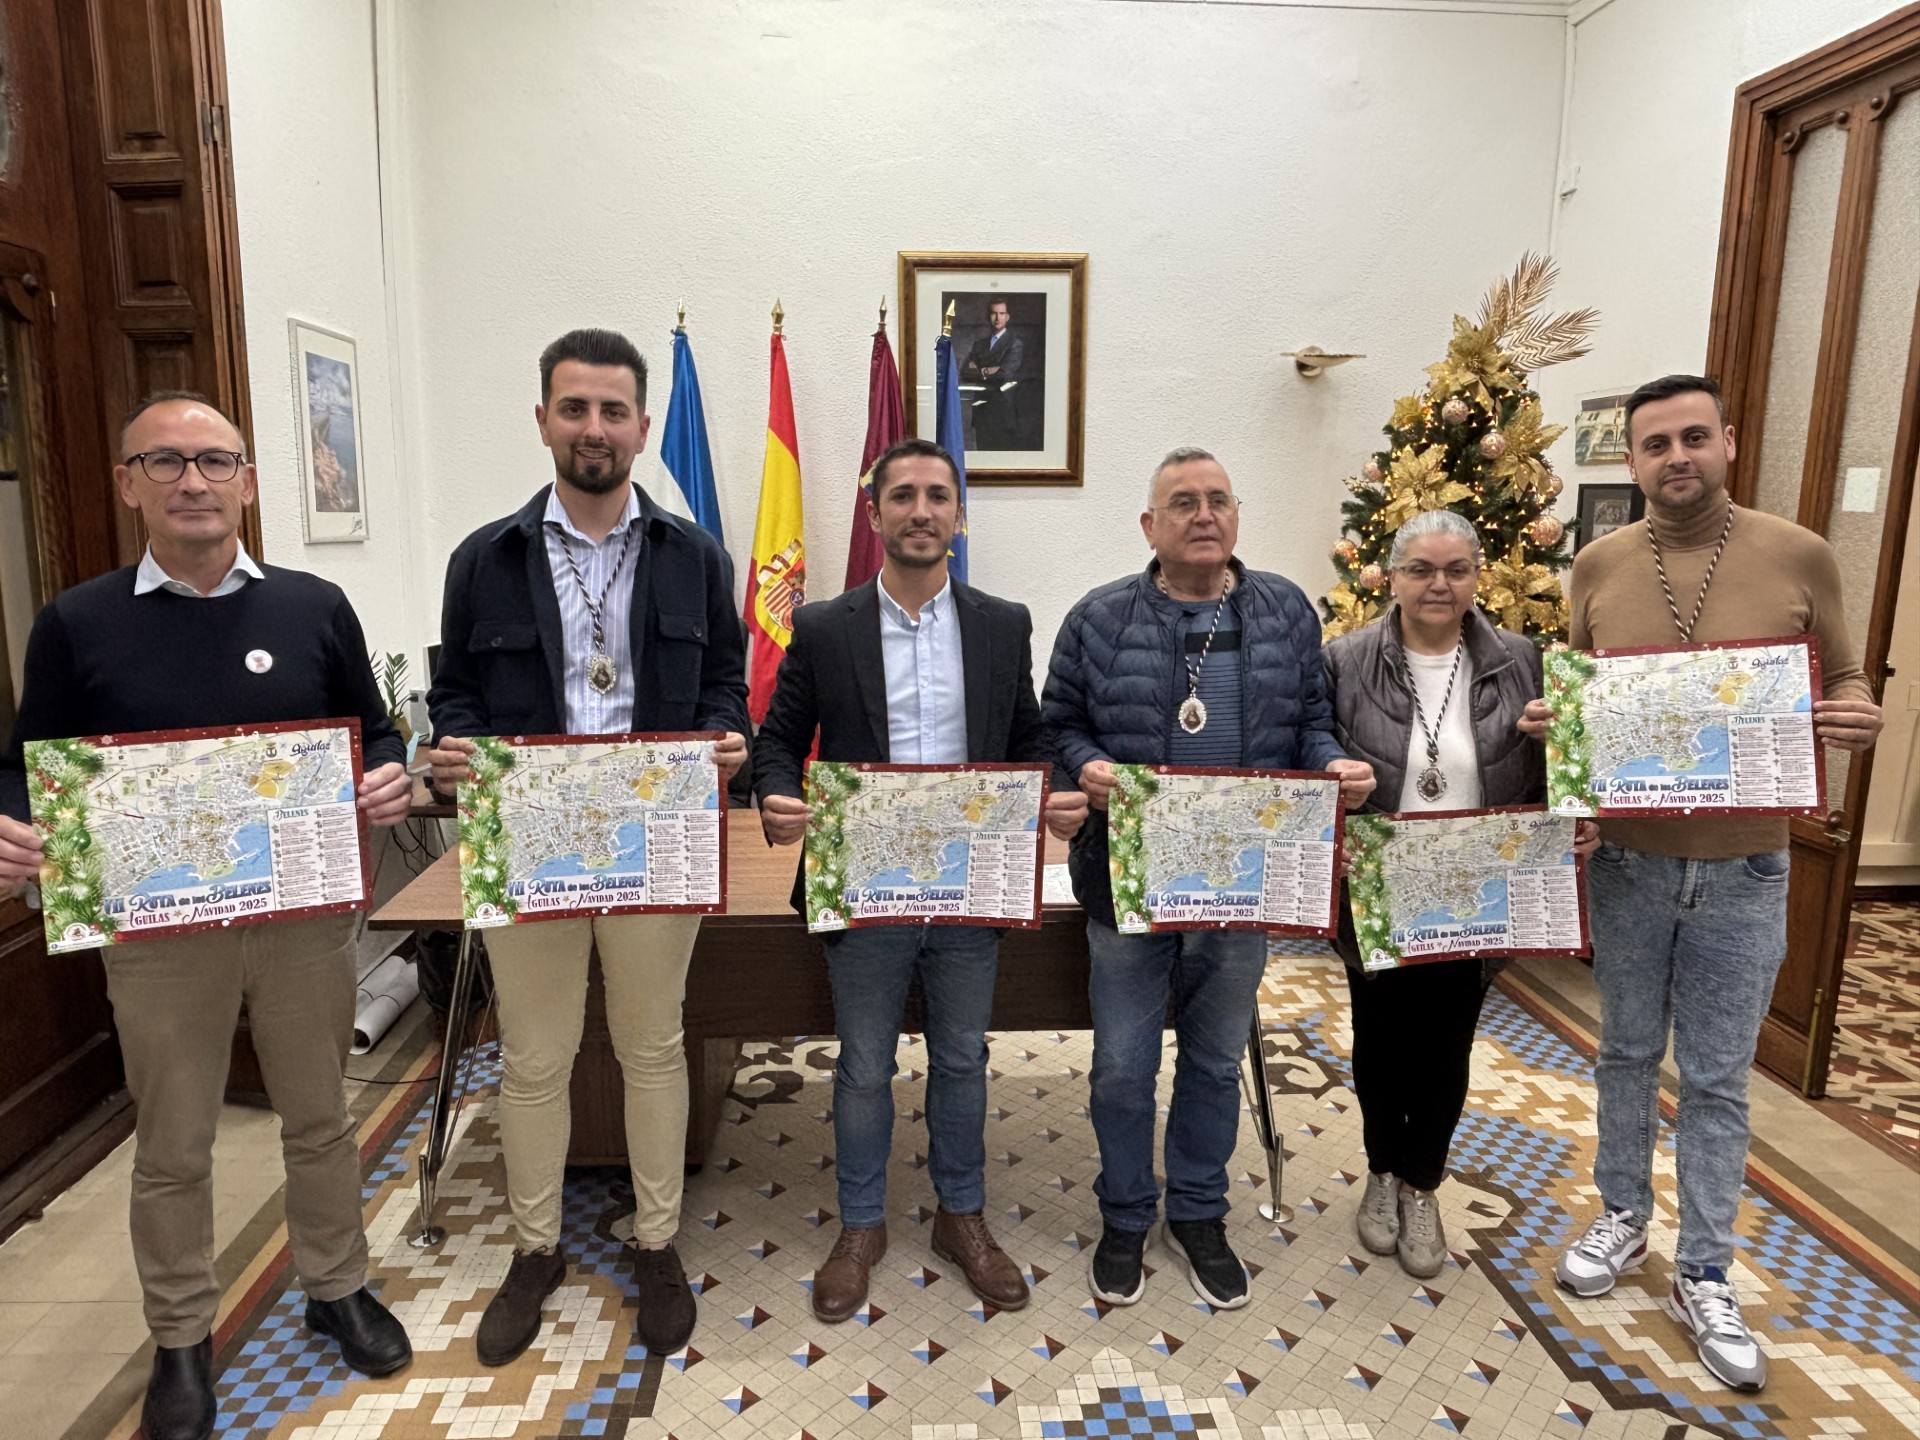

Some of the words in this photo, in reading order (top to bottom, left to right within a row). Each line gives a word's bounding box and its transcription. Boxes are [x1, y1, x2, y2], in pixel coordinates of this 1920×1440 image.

[1651, 792, 1696, 808] NAVIDAD
[1700, 793, 1724, 804] 2025
[103, 897, 125, 914] VII
[129, 892, 176, 912] RUTA
[206, 880, 272, 904] BELENES
[570, 892, 614, 909] NAVIDAD
[616, 890, 640, 902] 2025
[182, 904, 235, 925] NAVIDAD
[240, 898, 267, 911] 2025
[896, 901, 936, 916] NAVIDAD
[938, 903, 960, 912] 2025
[1234, 908, 1254, 917] 2025
[1442, 937, 1480, 952] NAVIDAD
[1482, 936, 1504, 946] 2025
